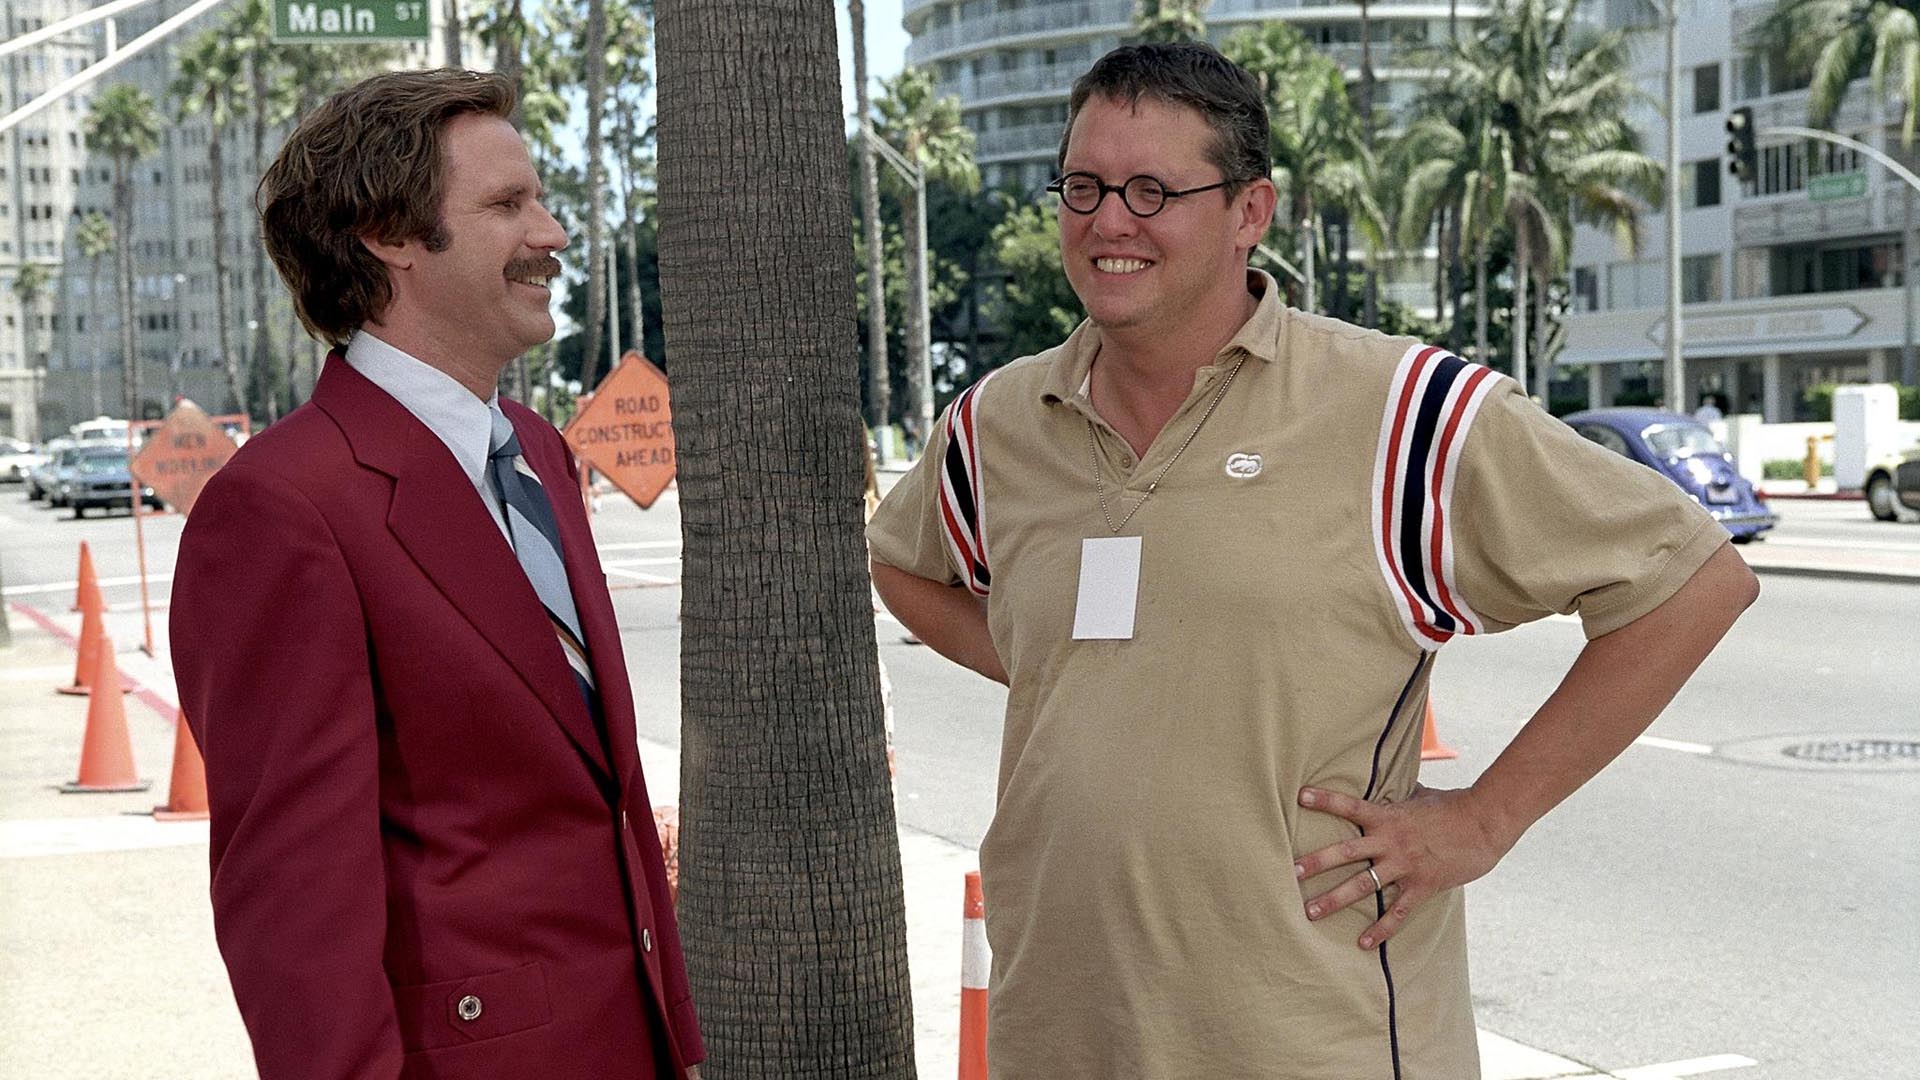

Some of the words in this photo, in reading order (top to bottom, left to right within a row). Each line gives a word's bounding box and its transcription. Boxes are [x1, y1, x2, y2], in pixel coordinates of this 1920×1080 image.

[288, 2, 376, 33] Main
[395, 1, 422, 21] ST
[614, 397, 660, 415] ROAD
[616, 448, 672, 467] AHEAD
